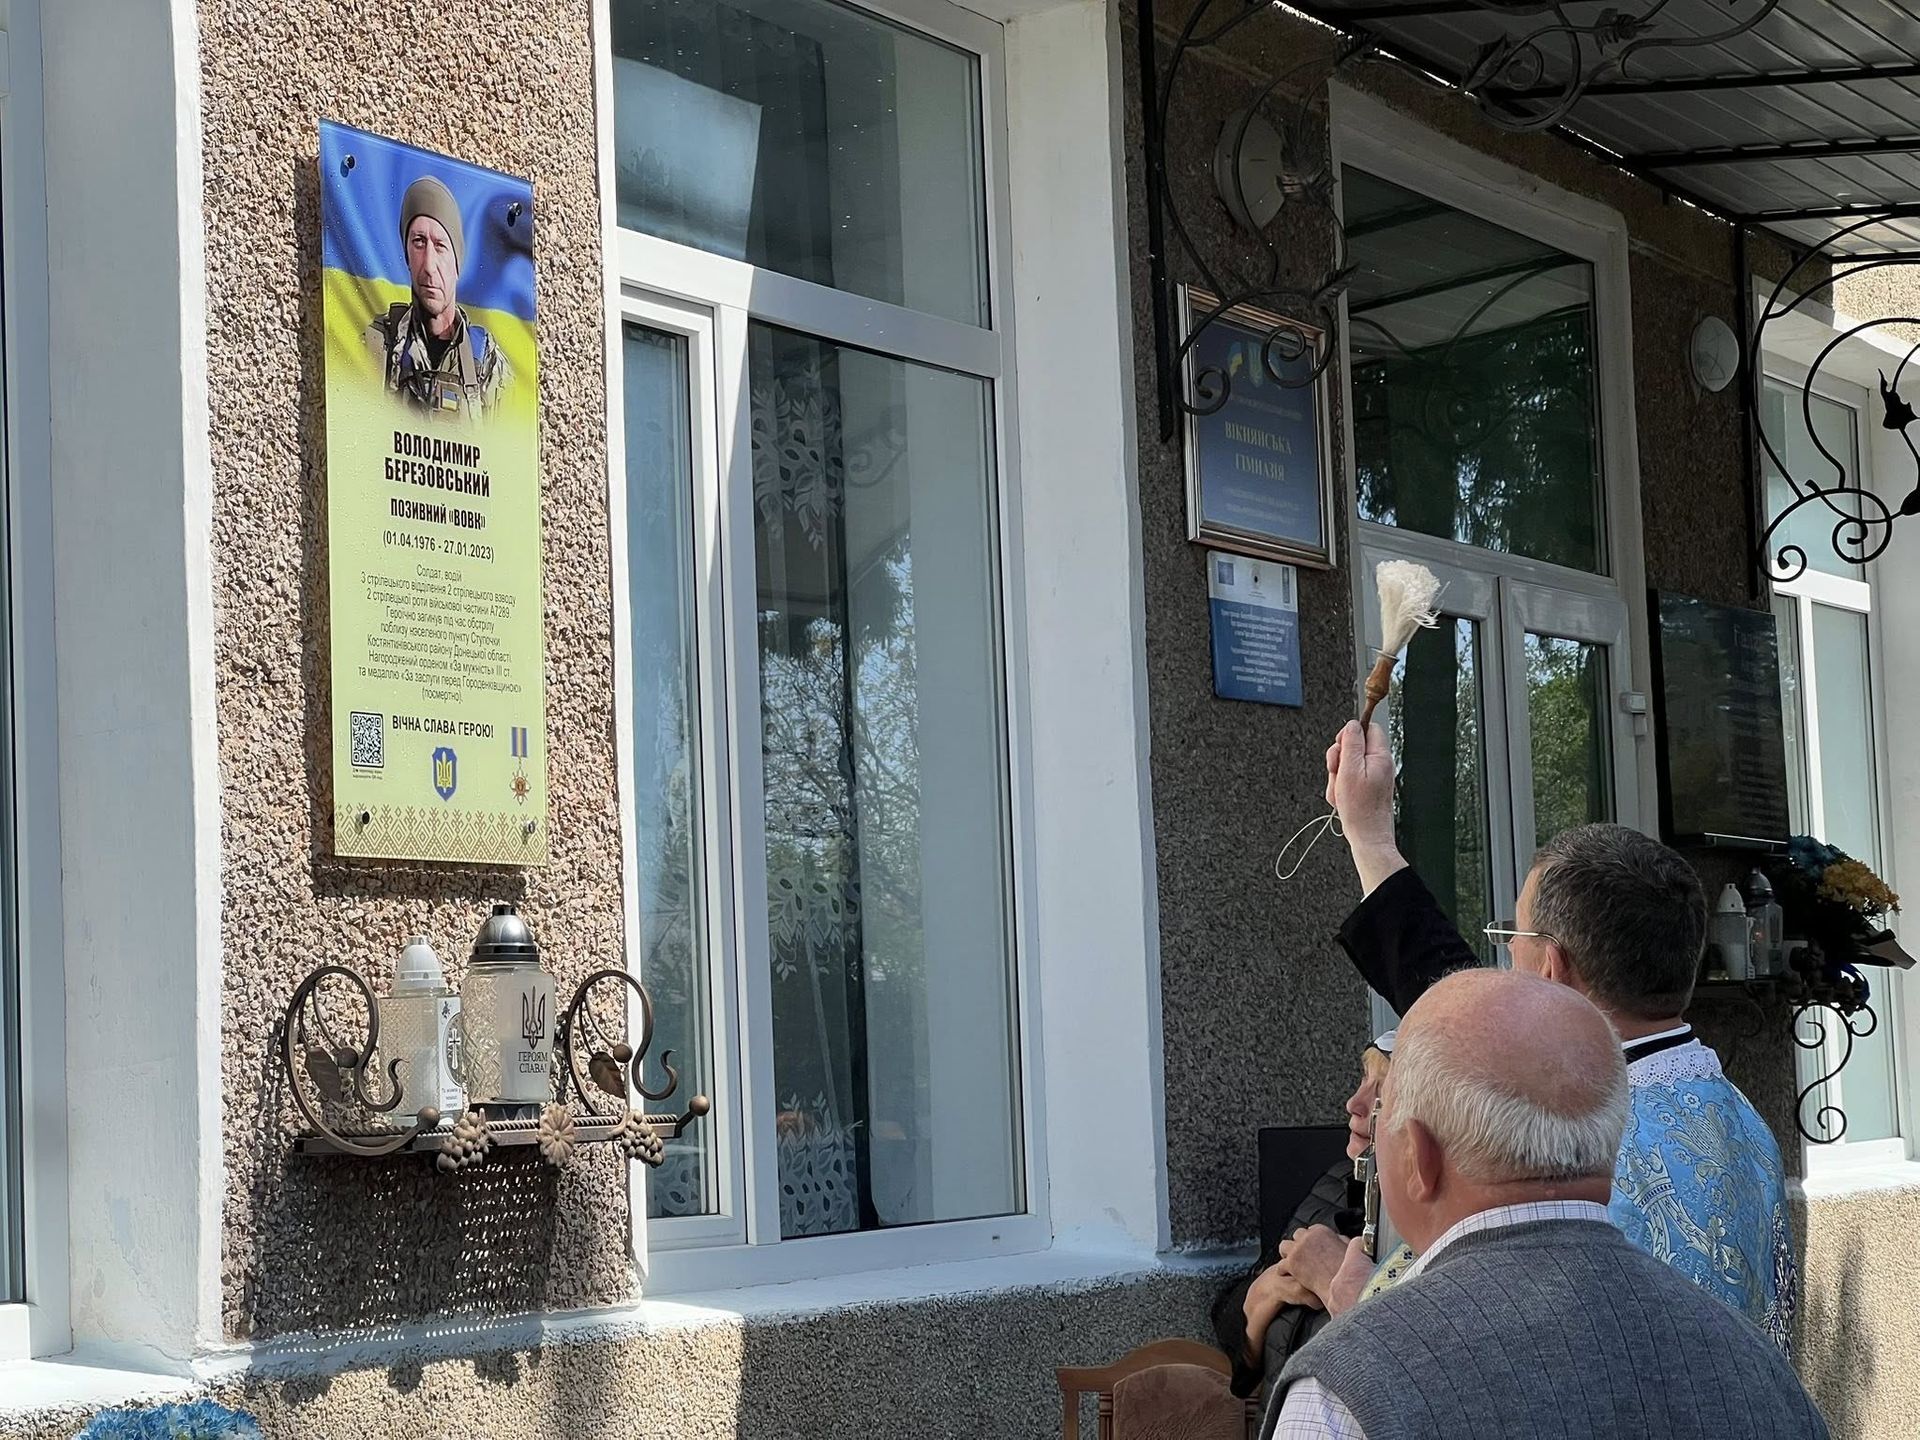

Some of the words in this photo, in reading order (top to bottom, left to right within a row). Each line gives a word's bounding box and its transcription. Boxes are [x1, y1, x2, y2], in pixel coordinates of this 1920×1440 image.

[394, 431, 480, 468] ВОЛОДИМИР
[385, 457, 490, 497] БЕРЕЗОВСЬКИЙ
[1236, 452, 1286, 481] ГІМНАЗІЯ
[391, 498, 446, 524] ПОЗИВНИЙ
[448, 508, 486, 531] «ВОВК»
[383, 530, 436, 551] (01.04.1976
[444, 540, 494, 563] 27.01.2023)
[361, 571, 366, 584] 3
[367, 575, 410, 590] стрілецького
[411, 581, 446, 594] відділення
[448, 584, 452, 595] 2
[453, 587, 494, 602] стрілецького
[494, 593, 516, 608] взводу
[445, 570, 462, 582] водій
[367, 588, 372, 600] 2
[373, 591, 412, 606] стрілецької
[412, 597, 428, 608] роти
[429, 597, 462, 612] військової
[463, 604, 488, 616] частини
[386, 606, 416, 621] Героїчно
[418, 612, 442, 627] загинув
[444, 616, 454, 628] під
[455, 617, 466, 628] час
[468, 617, 494, 634] обстрілу
[367, 634, 428, 654] Костянтинівського
[430, 643, 452, 658] району
[454, 645, 486, 660] Донецької
[380, 621, 408, 638] поблизу
[410, 627, 447, 640] населеного
[448, 632, 469, 646] пункту
[471, 632, 500, 647] Ступочки
[368, 650, 418, 668] Нагороджений
[419, 658, 448, 670] орденом
[450, 660, 462, 672] «За
[463, 664, 494, 676] мужність»
[359, 667, 366, 676] та
[368, 668, 400, 680] медаллю
[401, 668, 414, 681] «За
[415, 673, 440, 686] заслуги
[442, 676, 462, 688] перед
[392, 715, 422, 732] ВІЧНА
[424, 718, 456, 735] СЛАВА
[458, 722, 494, 738] ГЕРОЮ!
[518, 1052, 548, 1062] ГЕРОЯМ
[520, 1063, 547, 1074] СЛАВА!
